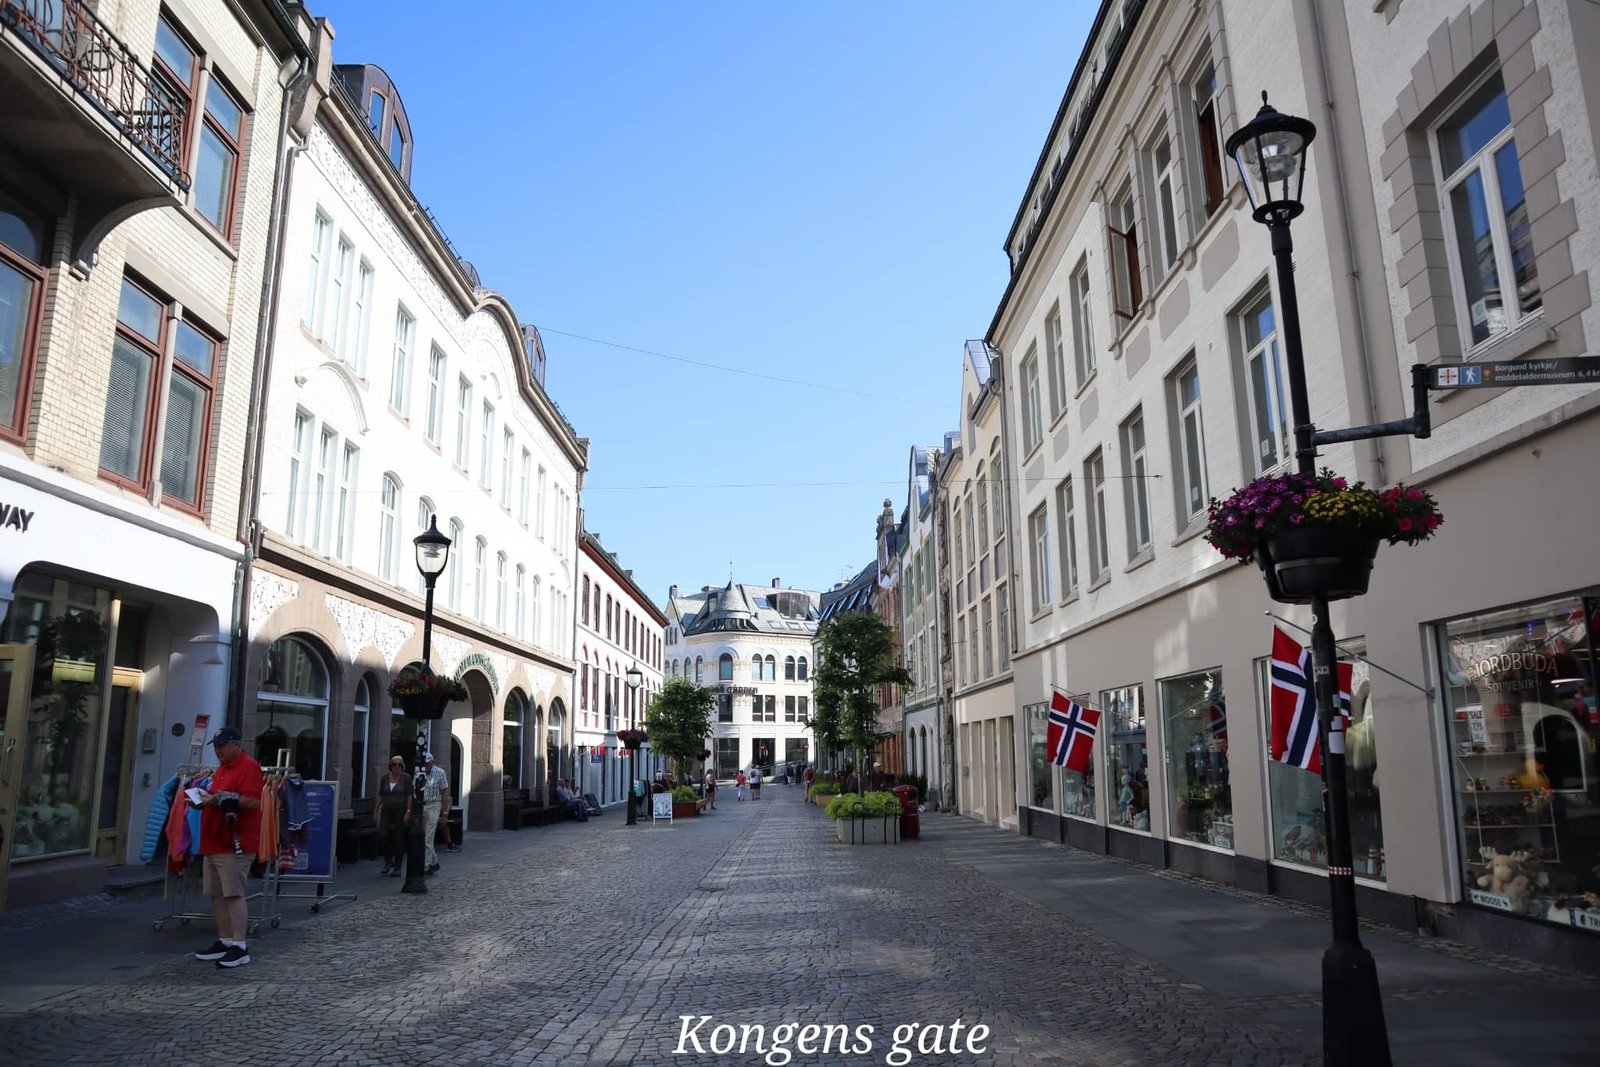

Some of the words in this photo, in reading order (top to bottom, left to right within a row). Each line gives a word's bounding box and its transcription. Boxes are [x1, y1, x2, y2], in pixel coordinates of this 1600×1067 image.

[1495, 363, 1526, 372] Borgund
[1495, 371, 1575, 381] middelaldermuseum
[1465, 652, 1558, 683] FJORDBUDA
[1487, 679, 1534, 693] SOUVENIR
[1480, 895, 1502, 907] MOOSE
